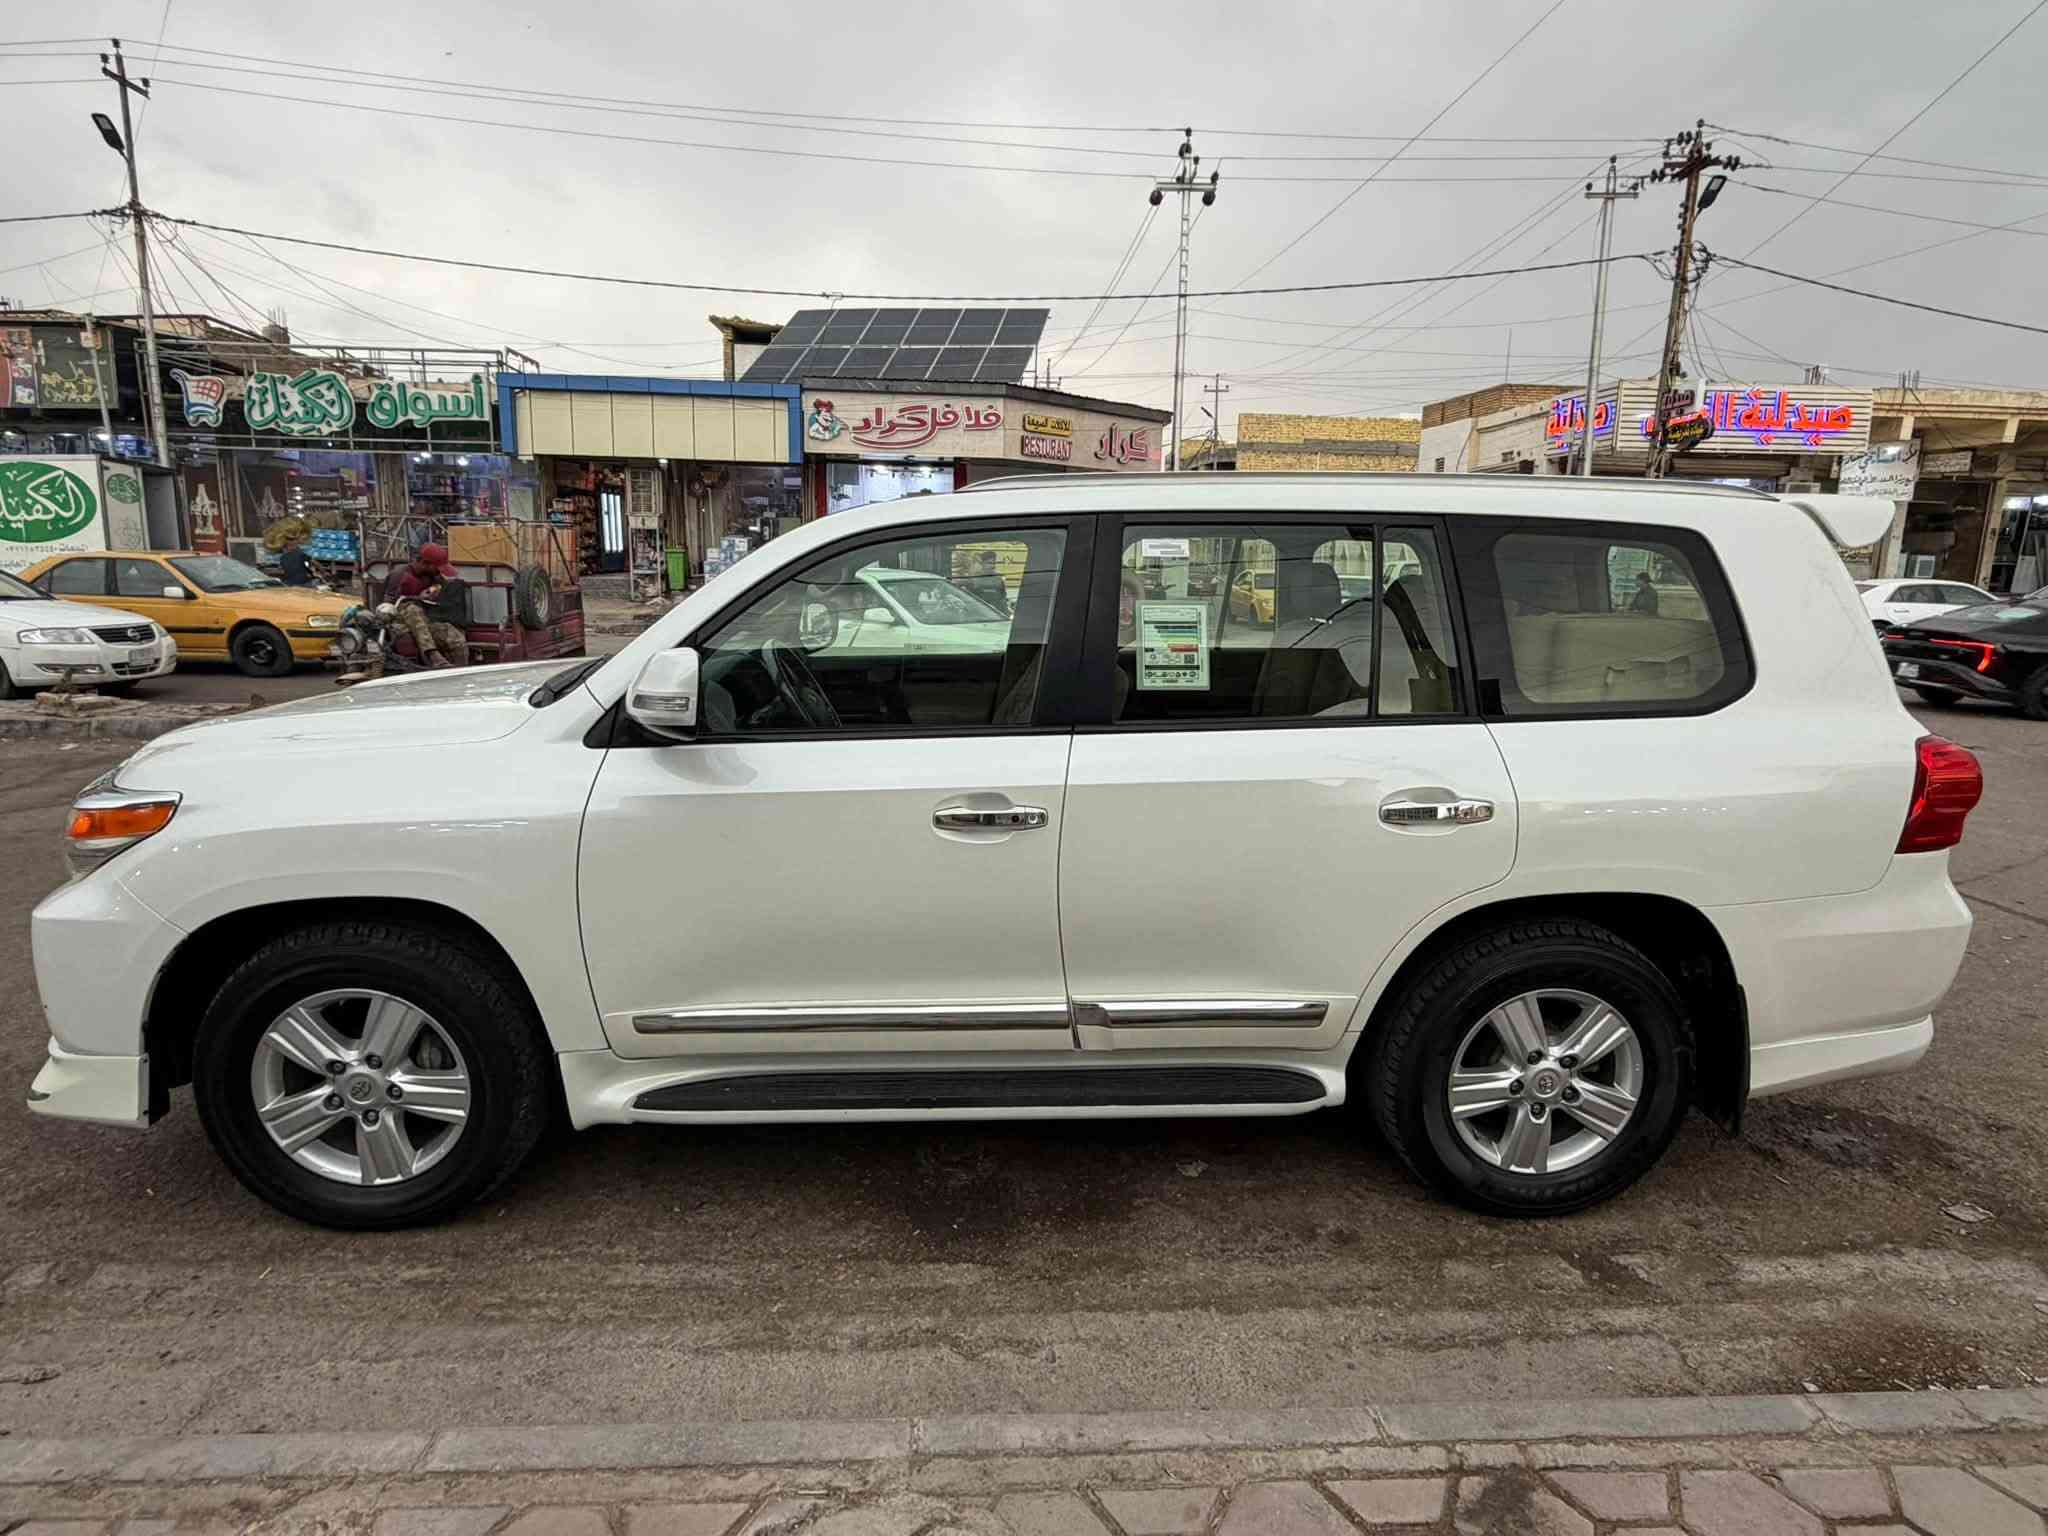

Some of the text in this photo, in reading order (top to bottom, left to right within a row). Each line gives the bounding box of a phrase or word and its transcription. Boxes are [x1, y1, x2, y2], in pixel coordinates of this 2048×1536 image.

[367, 373, 486, 430] أسواق
[850, 404, 930, 439] كرار
[1023, 436, 1073, 460] RESTURANT
[1094, 422, 1150, 464] كرار
